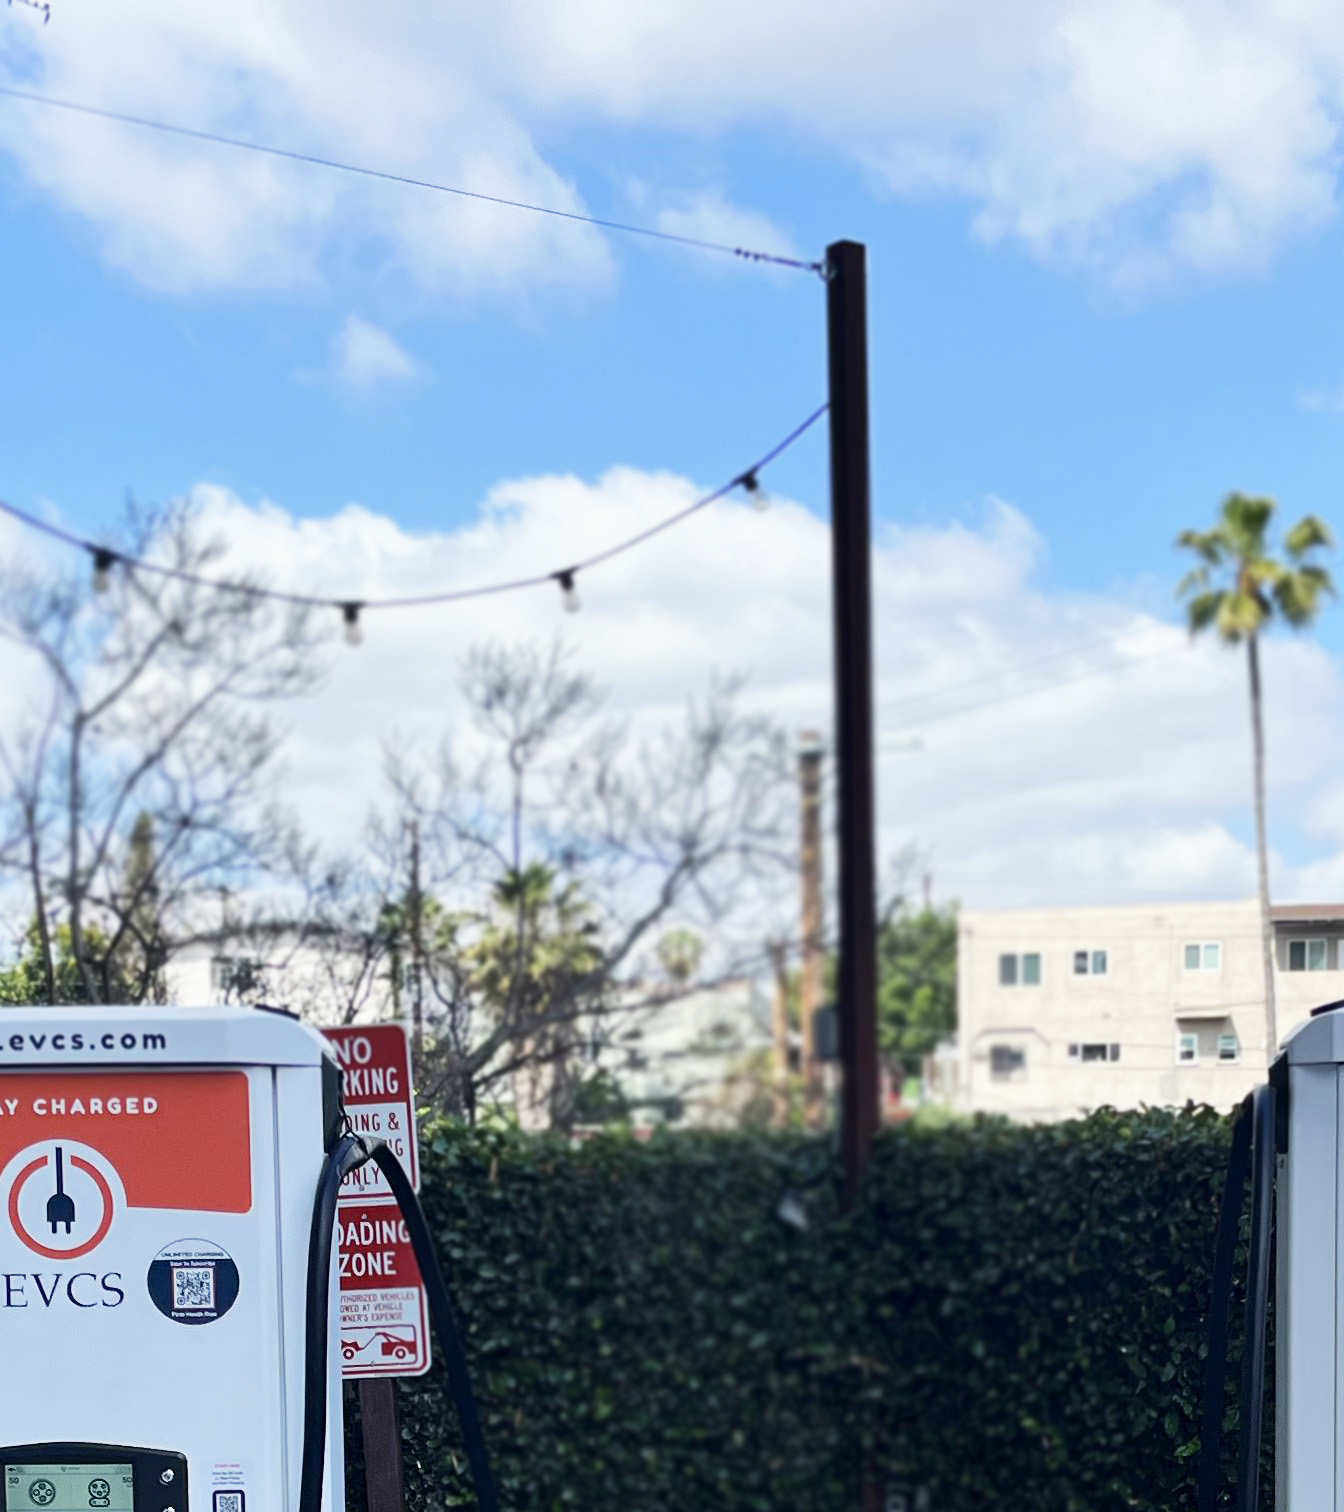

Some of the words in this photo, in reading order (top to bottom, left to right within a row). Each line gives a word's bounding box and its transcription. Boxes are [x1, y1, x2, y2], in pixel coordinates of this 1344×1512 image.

[331, 1036, 372, 1065] NO
[343, 1067, 399, 1097] RKING
[33, 1096, 159, 1116] CHARGED
[345, 1113, 381, 1132] DING
[388, 1111, 400, 1131] &
[339, 1251, 397, 1277] ZONE
[2, 1271, 125, 1309] EVCS
[381, 1291, 415, 1301] VEHICLES
[340, 1304, 359, 1313] OWED
[362, 1303, 371, 1312] AT
[374, 1302, 403, 1312] VEHICLE
[340, 1313, 369, 1322] WNER'S
[371, 1311, 403, 1321] EXPENSE
